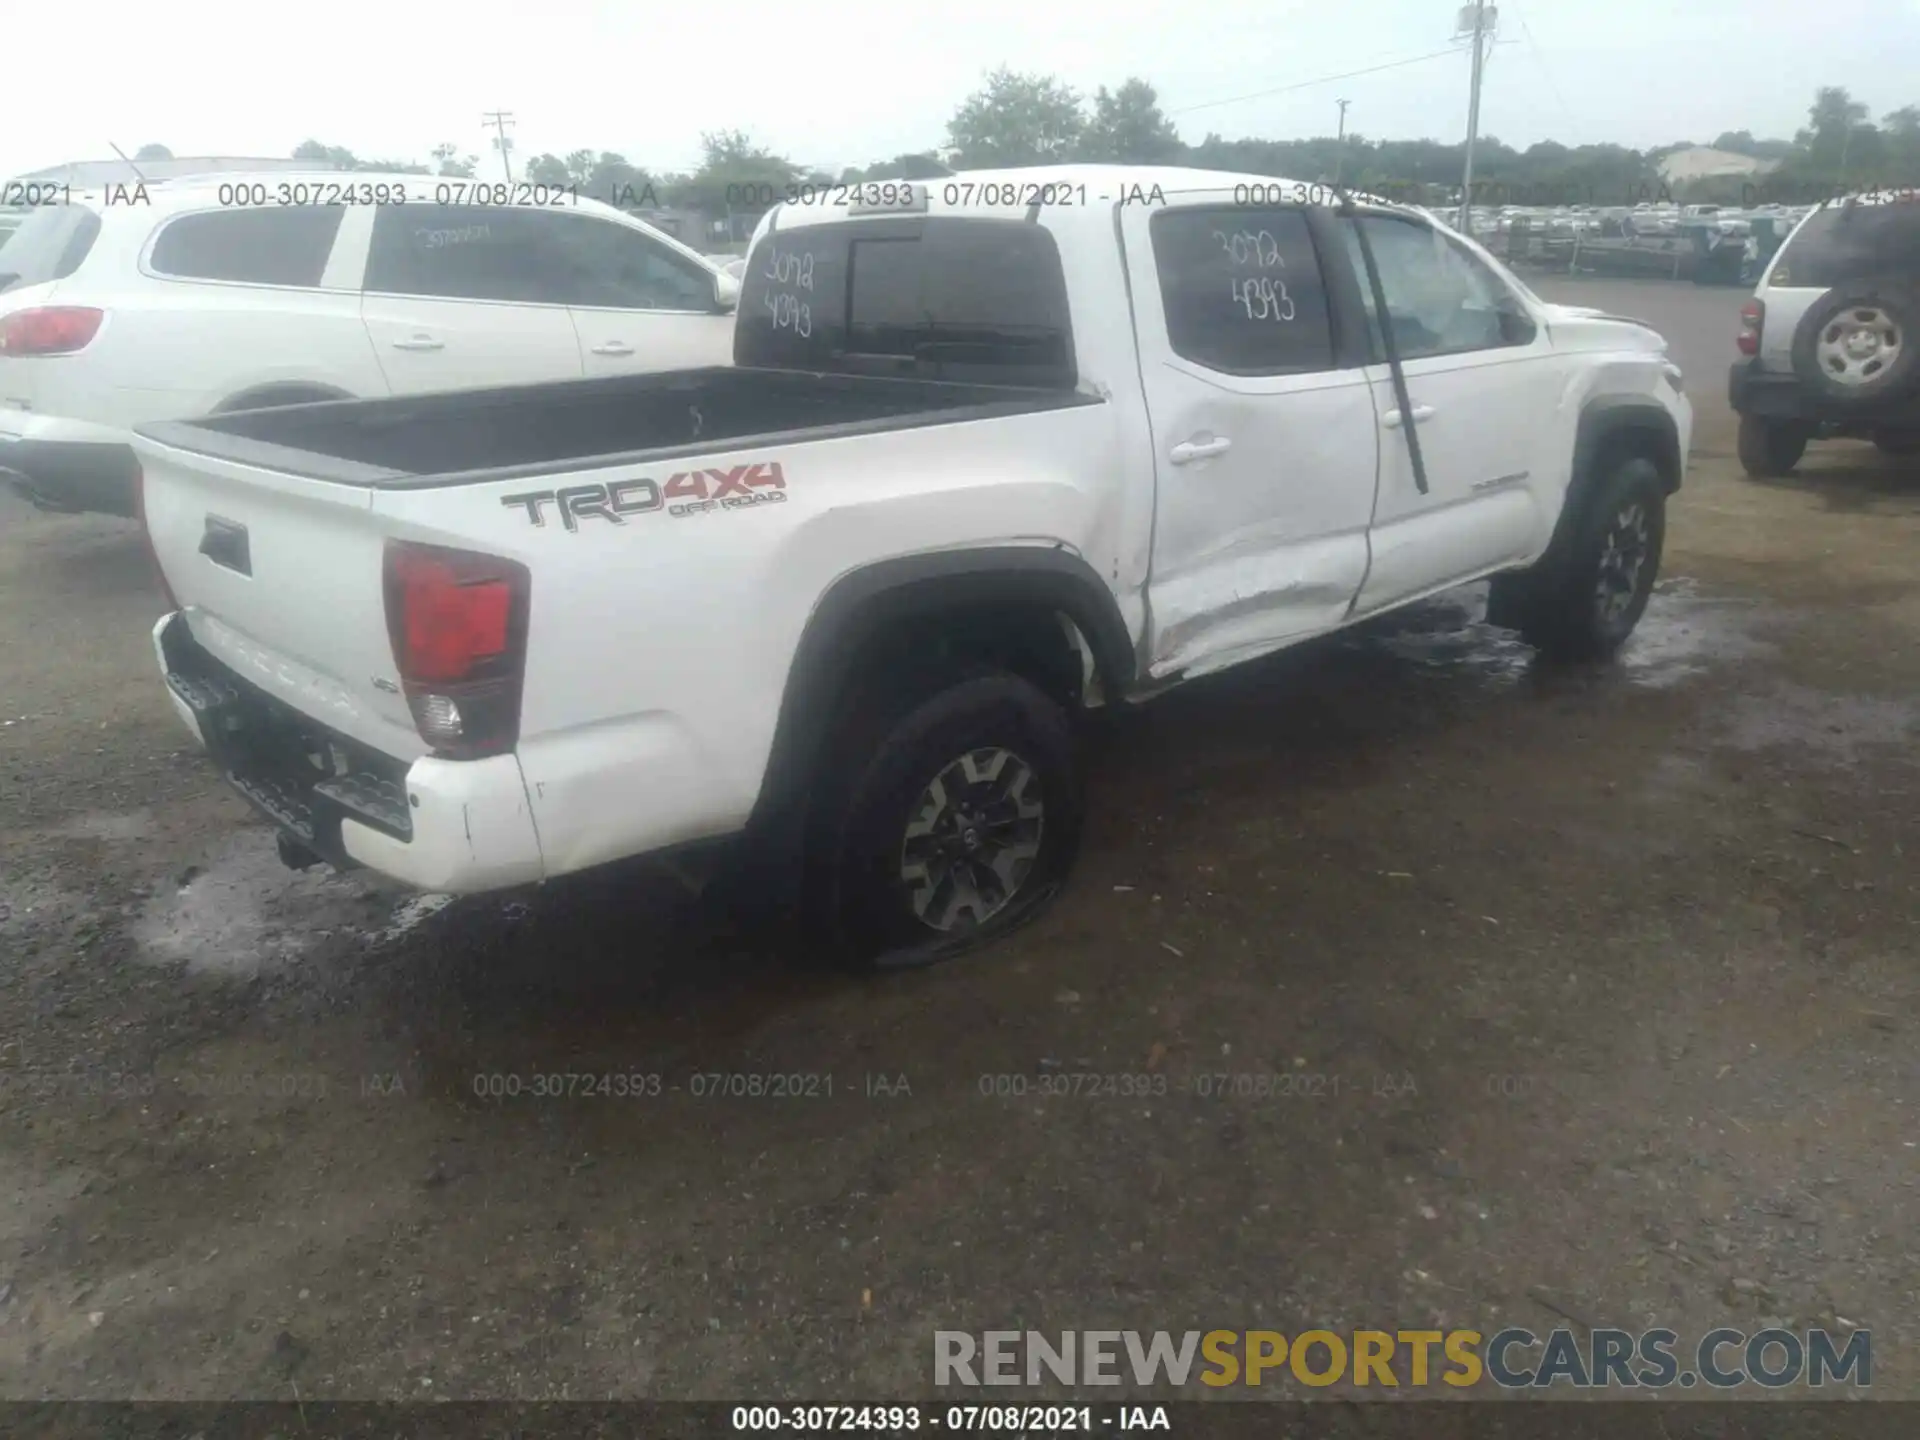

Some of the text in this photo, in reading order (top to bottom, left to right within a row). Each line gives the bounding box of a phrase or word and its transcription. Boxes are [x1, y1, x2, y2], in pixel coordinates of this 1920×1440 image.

[1231, 276, 1295, 321] 4393
[500, 477, 665, 533] TRD
[667, 490, 788, 518] OFF ROAD
